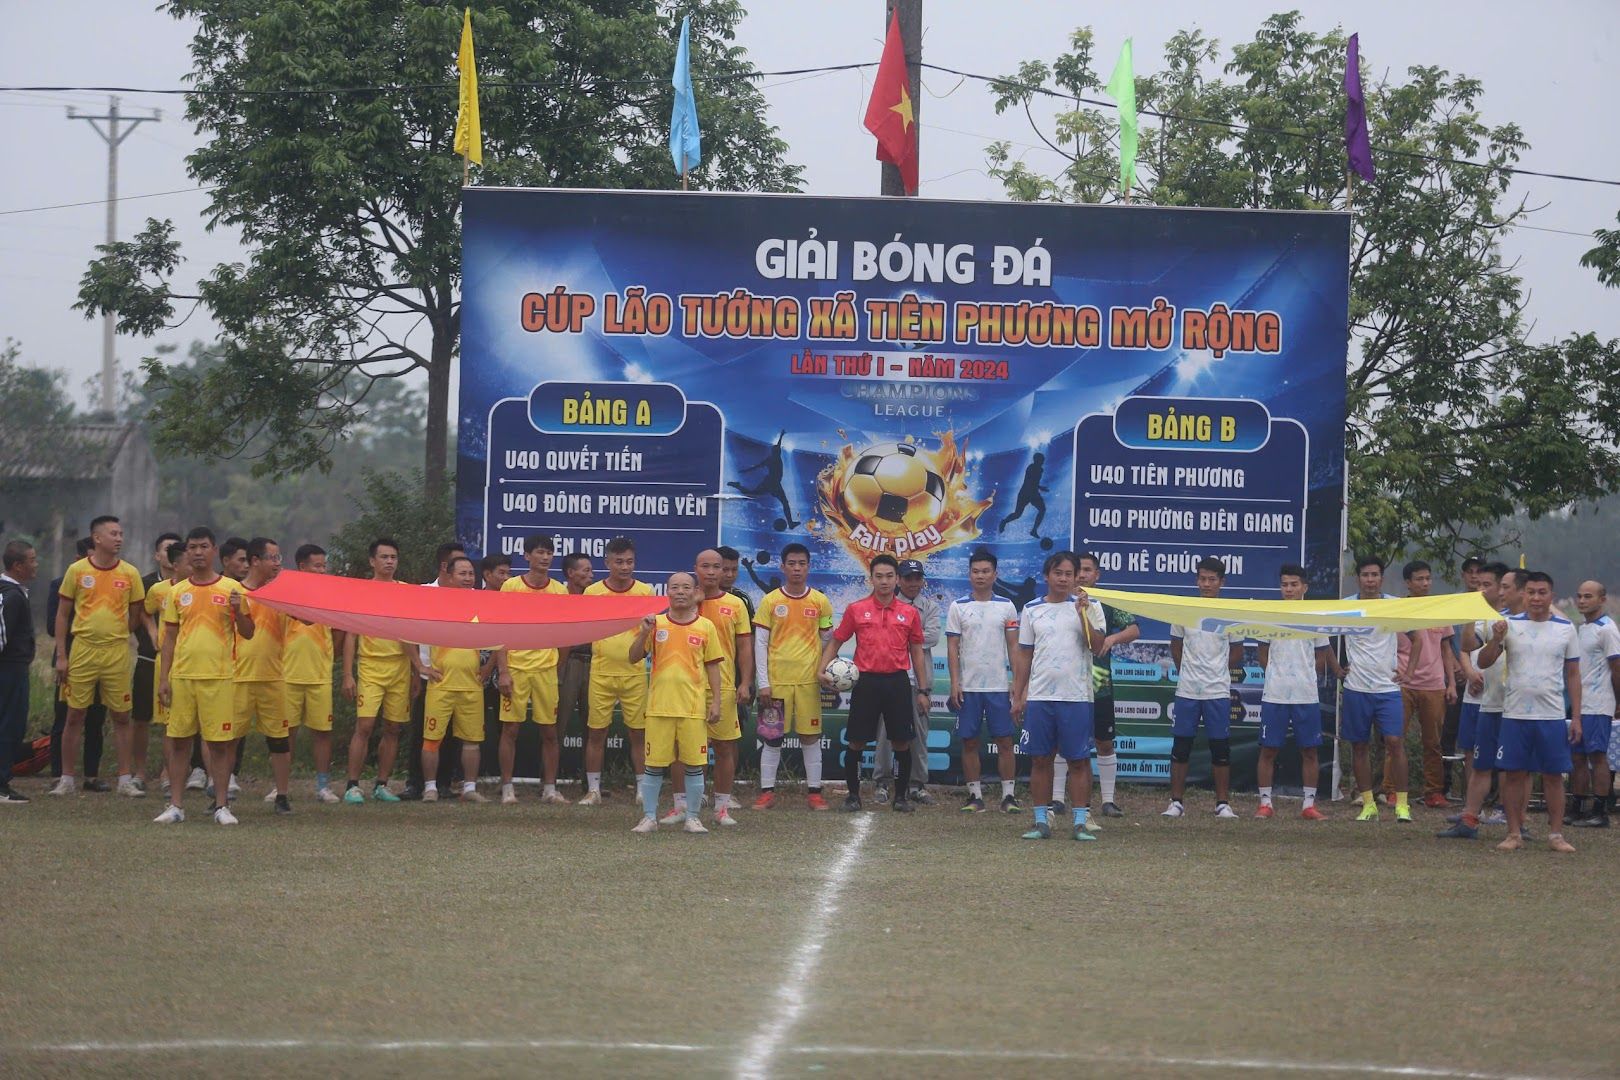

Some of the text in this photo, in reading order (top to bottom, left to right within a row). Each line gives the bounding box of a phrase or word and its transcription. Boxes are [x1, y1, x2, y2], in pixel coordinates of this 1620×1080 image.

[755, 227, 1052, 287] GIẢI BÓNG ĐÁ
[521, 285, 1281, 360] CÚP LÃO TƯỚNG XÃ TIÊN PHƯƠNG MỞ RỘNG
[791, 348, 827, 375] LẦN
[833, 352, 873, 376] THỨ
[877, 356, 884, 376] I
[908, 355, 955, 379] NĂM
[960, 359, 1008, 380] 2024
[562, 391, 651, 426] BẢNG A
[874, 403, 945, 418] LEAGUE
[1147, 406, 1236, 442] BẢNG B
[505, 444, 643, 471] U40 QUYẾT TIẾN
[1090, 463, 1245, 488] U40 TIÊN PHƯƠNG
[503, 491, 707, 516] U40 ĐÔNG PHƯƠNG YÊN
[1089, 506, 1294, 533] U40 PHƯỜNG BIÊN GIANG
[502, 536, 525, 556] U4
[551, 534, 575, 557] ÊN
[849, 523, 942, 557] Fair play
[1128, 549, 1149, 572] KÊ
[1210, 554, 1243, 575] ƠN
[818, 734, 832, 750] ẾT
